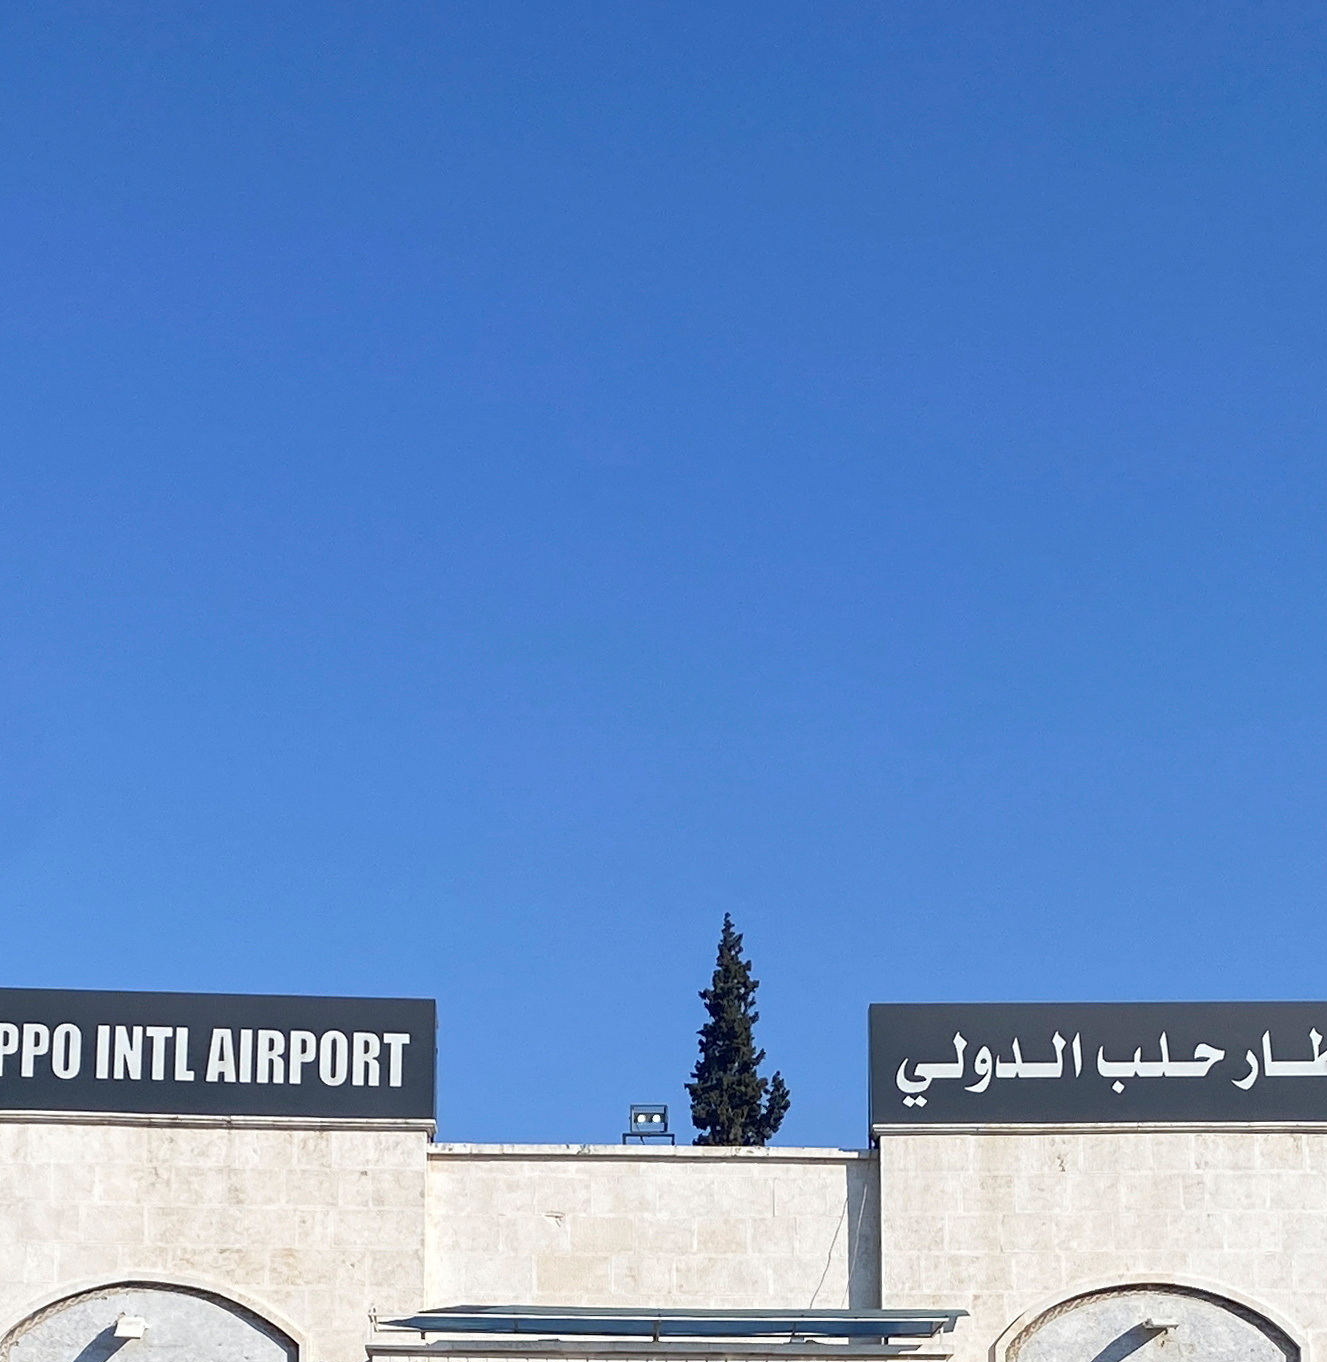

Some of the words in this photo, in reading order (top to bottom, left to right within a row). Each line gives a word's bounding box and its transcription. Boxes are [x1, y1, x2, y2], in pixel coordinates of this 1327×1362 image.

[94, 1024, 195, 1083] INTL
[205, 1027, 412, 1088] AIRPORT
[895, 1030, 1083, 1109] الدولي
[1096, 1031, 1226, 1095] حلب
